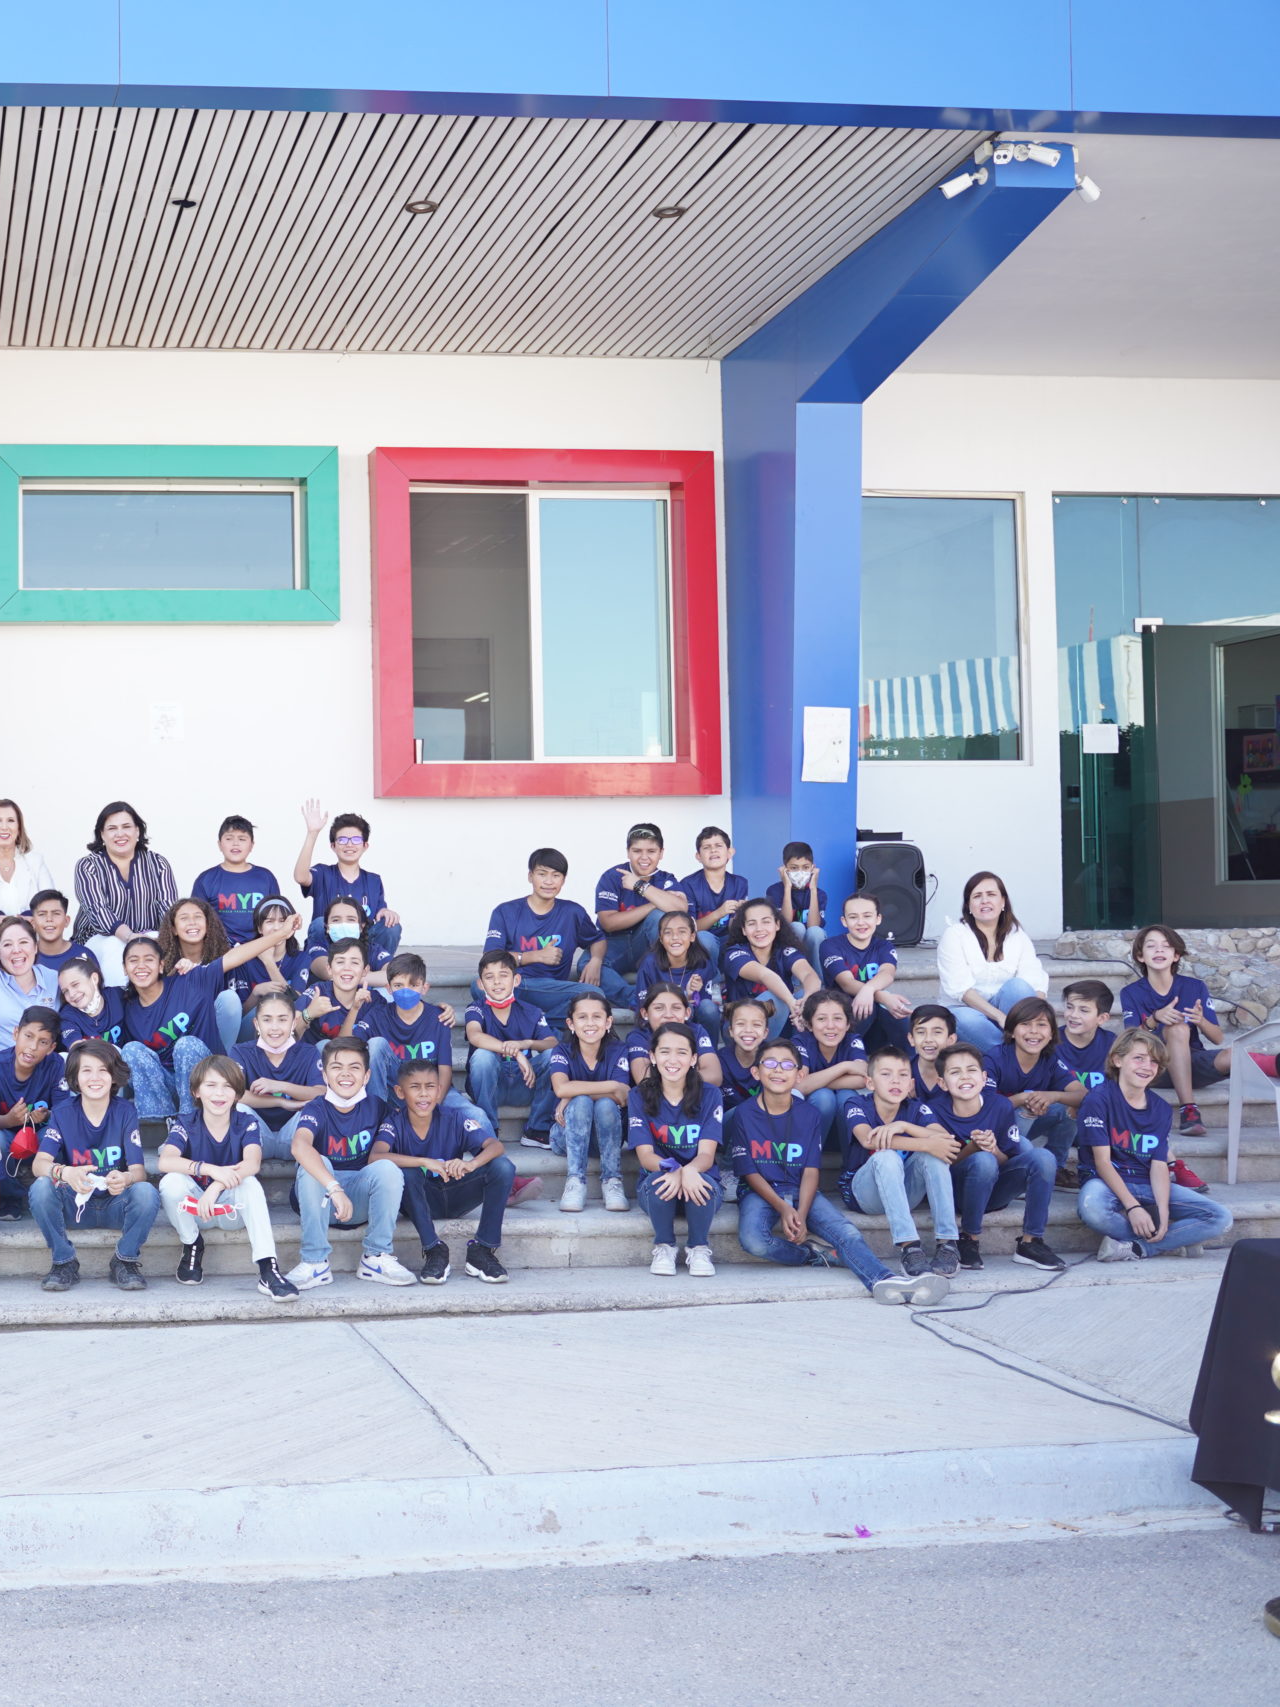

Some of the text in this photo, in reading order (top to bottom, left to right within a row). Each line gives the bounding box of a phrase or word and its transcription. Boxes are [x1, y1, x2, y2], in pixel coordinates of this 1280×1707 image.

[218, 893, 264, 910] MYP
[389, 1041, 435, 1059] MYP
[1071, 1071, 1104, 1088] YP
[327, 1130, 371, 1155] MYP
[649, 1121, 700, 1144] MYP
[1111, 1127, 1159, 1153] MYP
[72, 1145, 121, 1166] MYP
[751, 1140, 803, 1162] MYP
